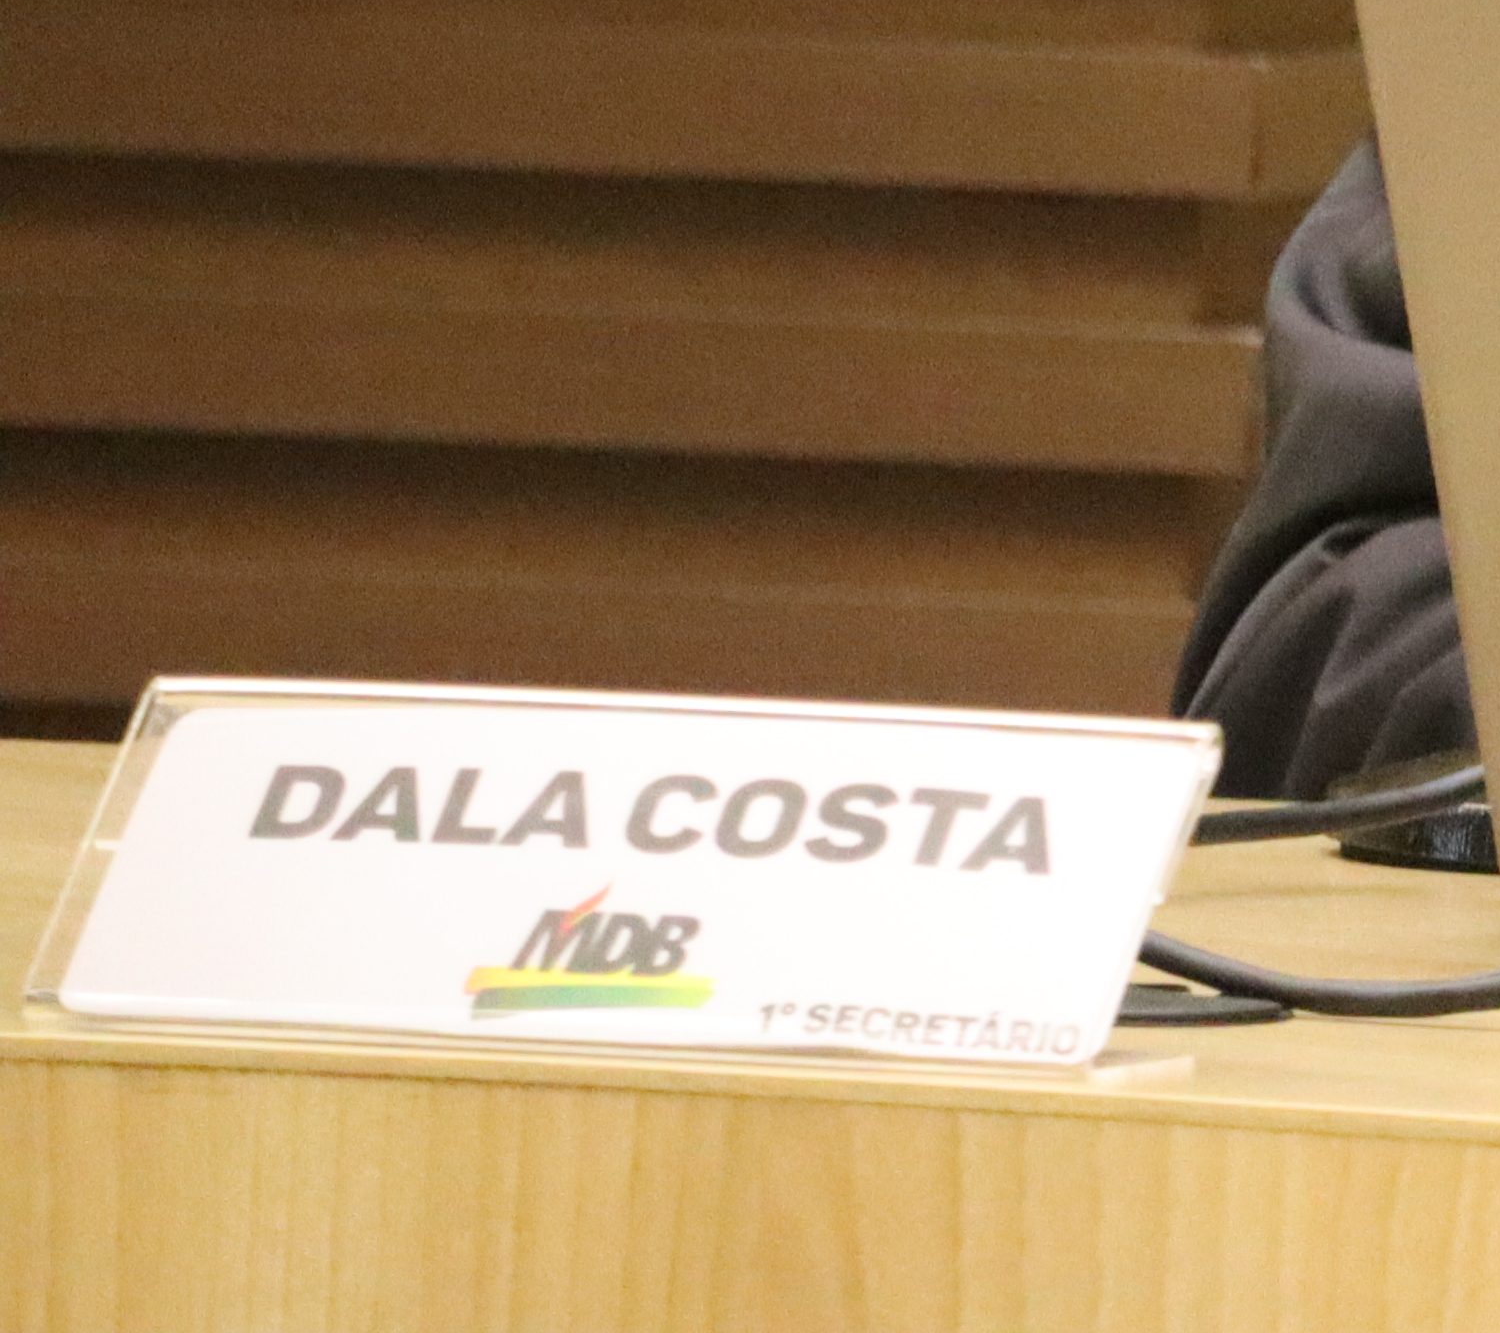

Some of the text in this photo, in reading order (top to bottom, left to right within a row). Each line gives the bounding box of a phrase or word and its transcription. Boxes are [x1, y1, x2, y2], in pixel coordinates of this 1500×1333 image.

[249, 763, 1052, 876] DALA COSTA
[509, 901, 702, 976] MDB
[803, 1003, 1081, 1055] SECRETÁRIO
